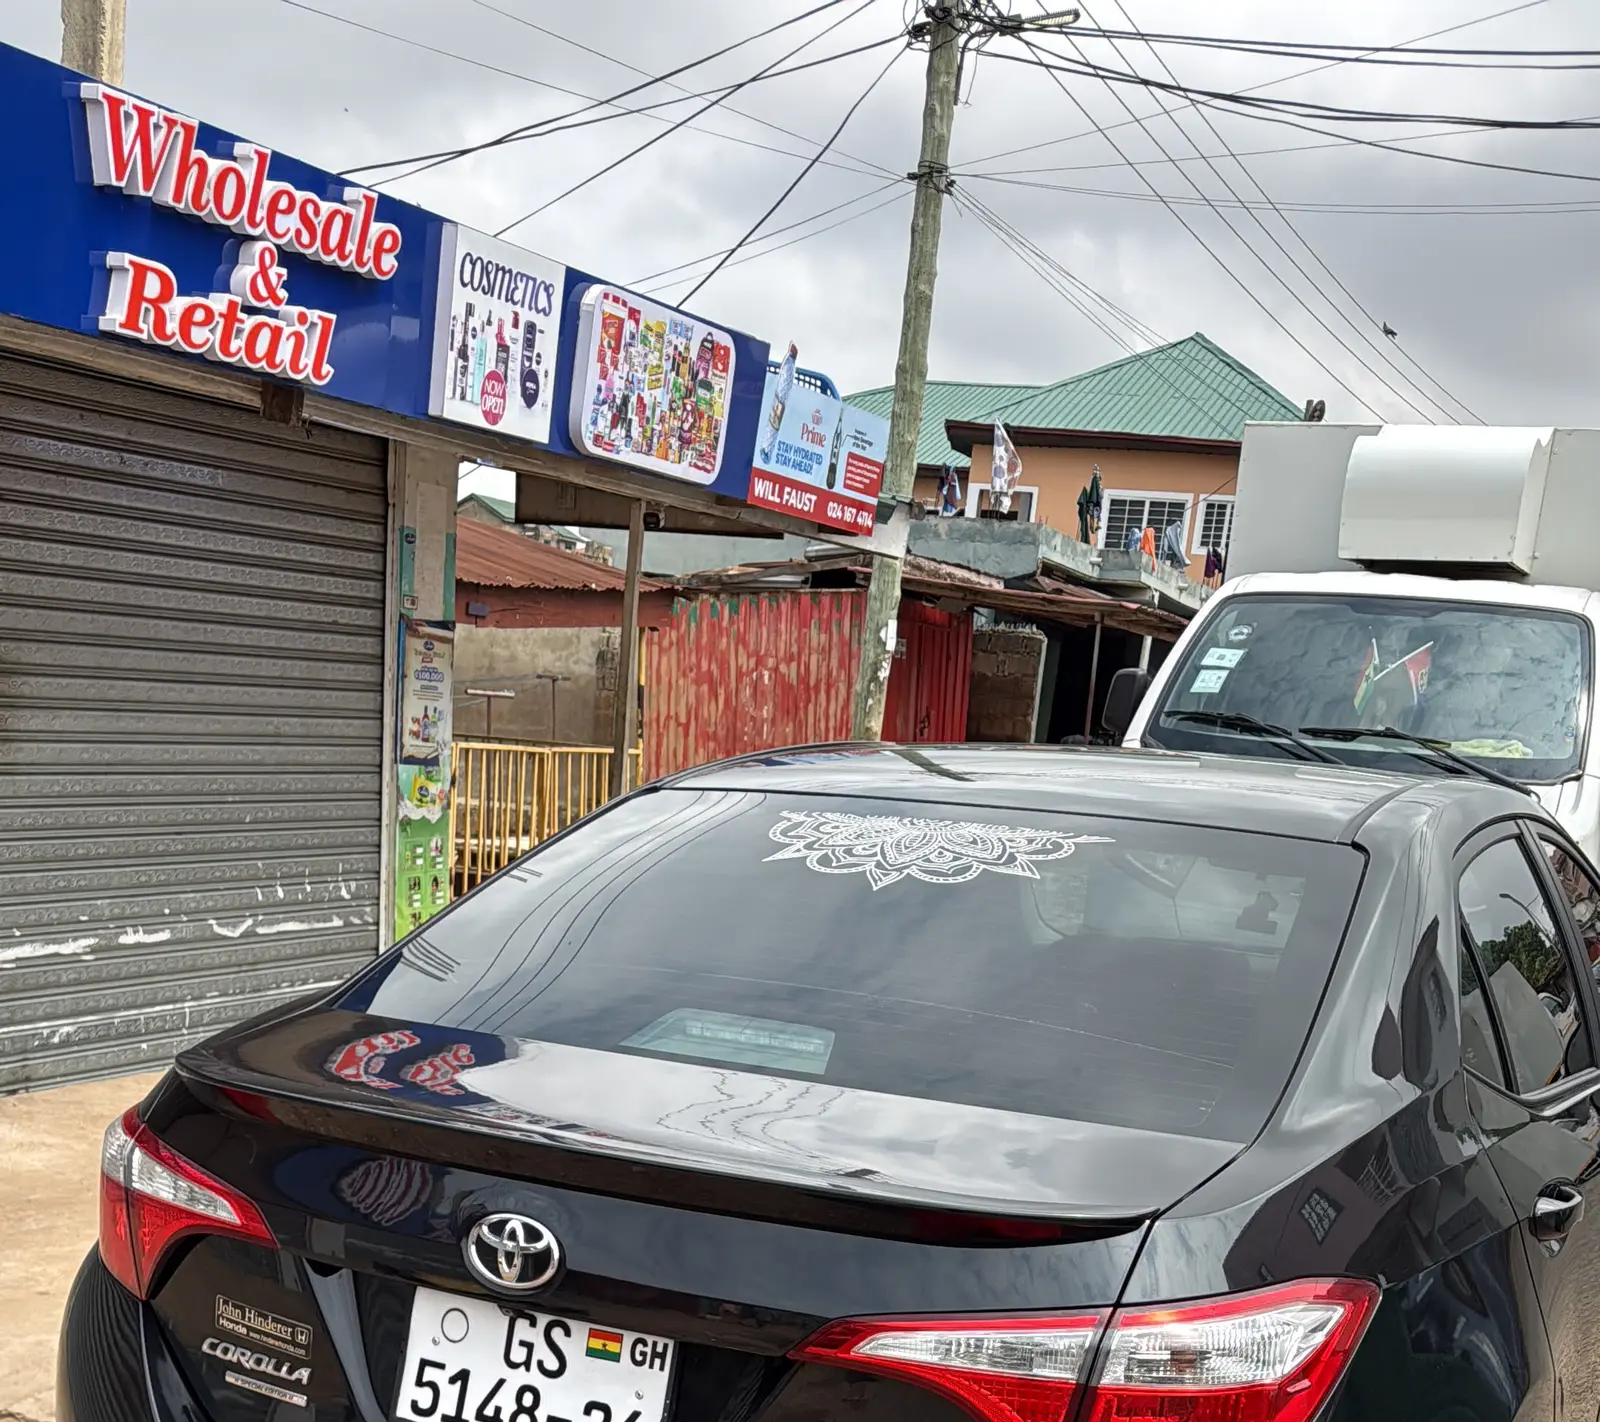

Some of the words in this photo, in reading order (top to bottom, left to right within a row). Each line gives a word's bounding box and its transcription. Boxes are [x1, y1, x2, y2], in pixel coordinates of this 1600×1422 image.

[92, 86, 401, 279] Wholesale
[242, 242, 287, 308] &
[460, 252, 555, 317] COSMETICS
[110, 253, 335, 384] Retail
[483, 378, 506, 397] NOW
[777, 440, 793, 455] STAY
[793, 445, 823, 466] HYDRATED
[801, 423, 826, 447] Prime
[775, 452, 792, 468] STAY
[754, 477, 780, 502] WILL
[783, 486, 817, 513] FAUST
[827, 501, 842, 520] 024
[844, 506, 857, 523] 167
[218, 1298, 242, 1320] John
[245, 1307, 293, 1337] Hinderer
[219, 1316, 247, 1335] Honda
[201, 1337, 312, 1385] COROLLA
[503, 1311, 572, 1379] GS
[629, 1337, 670, 1372] GH
